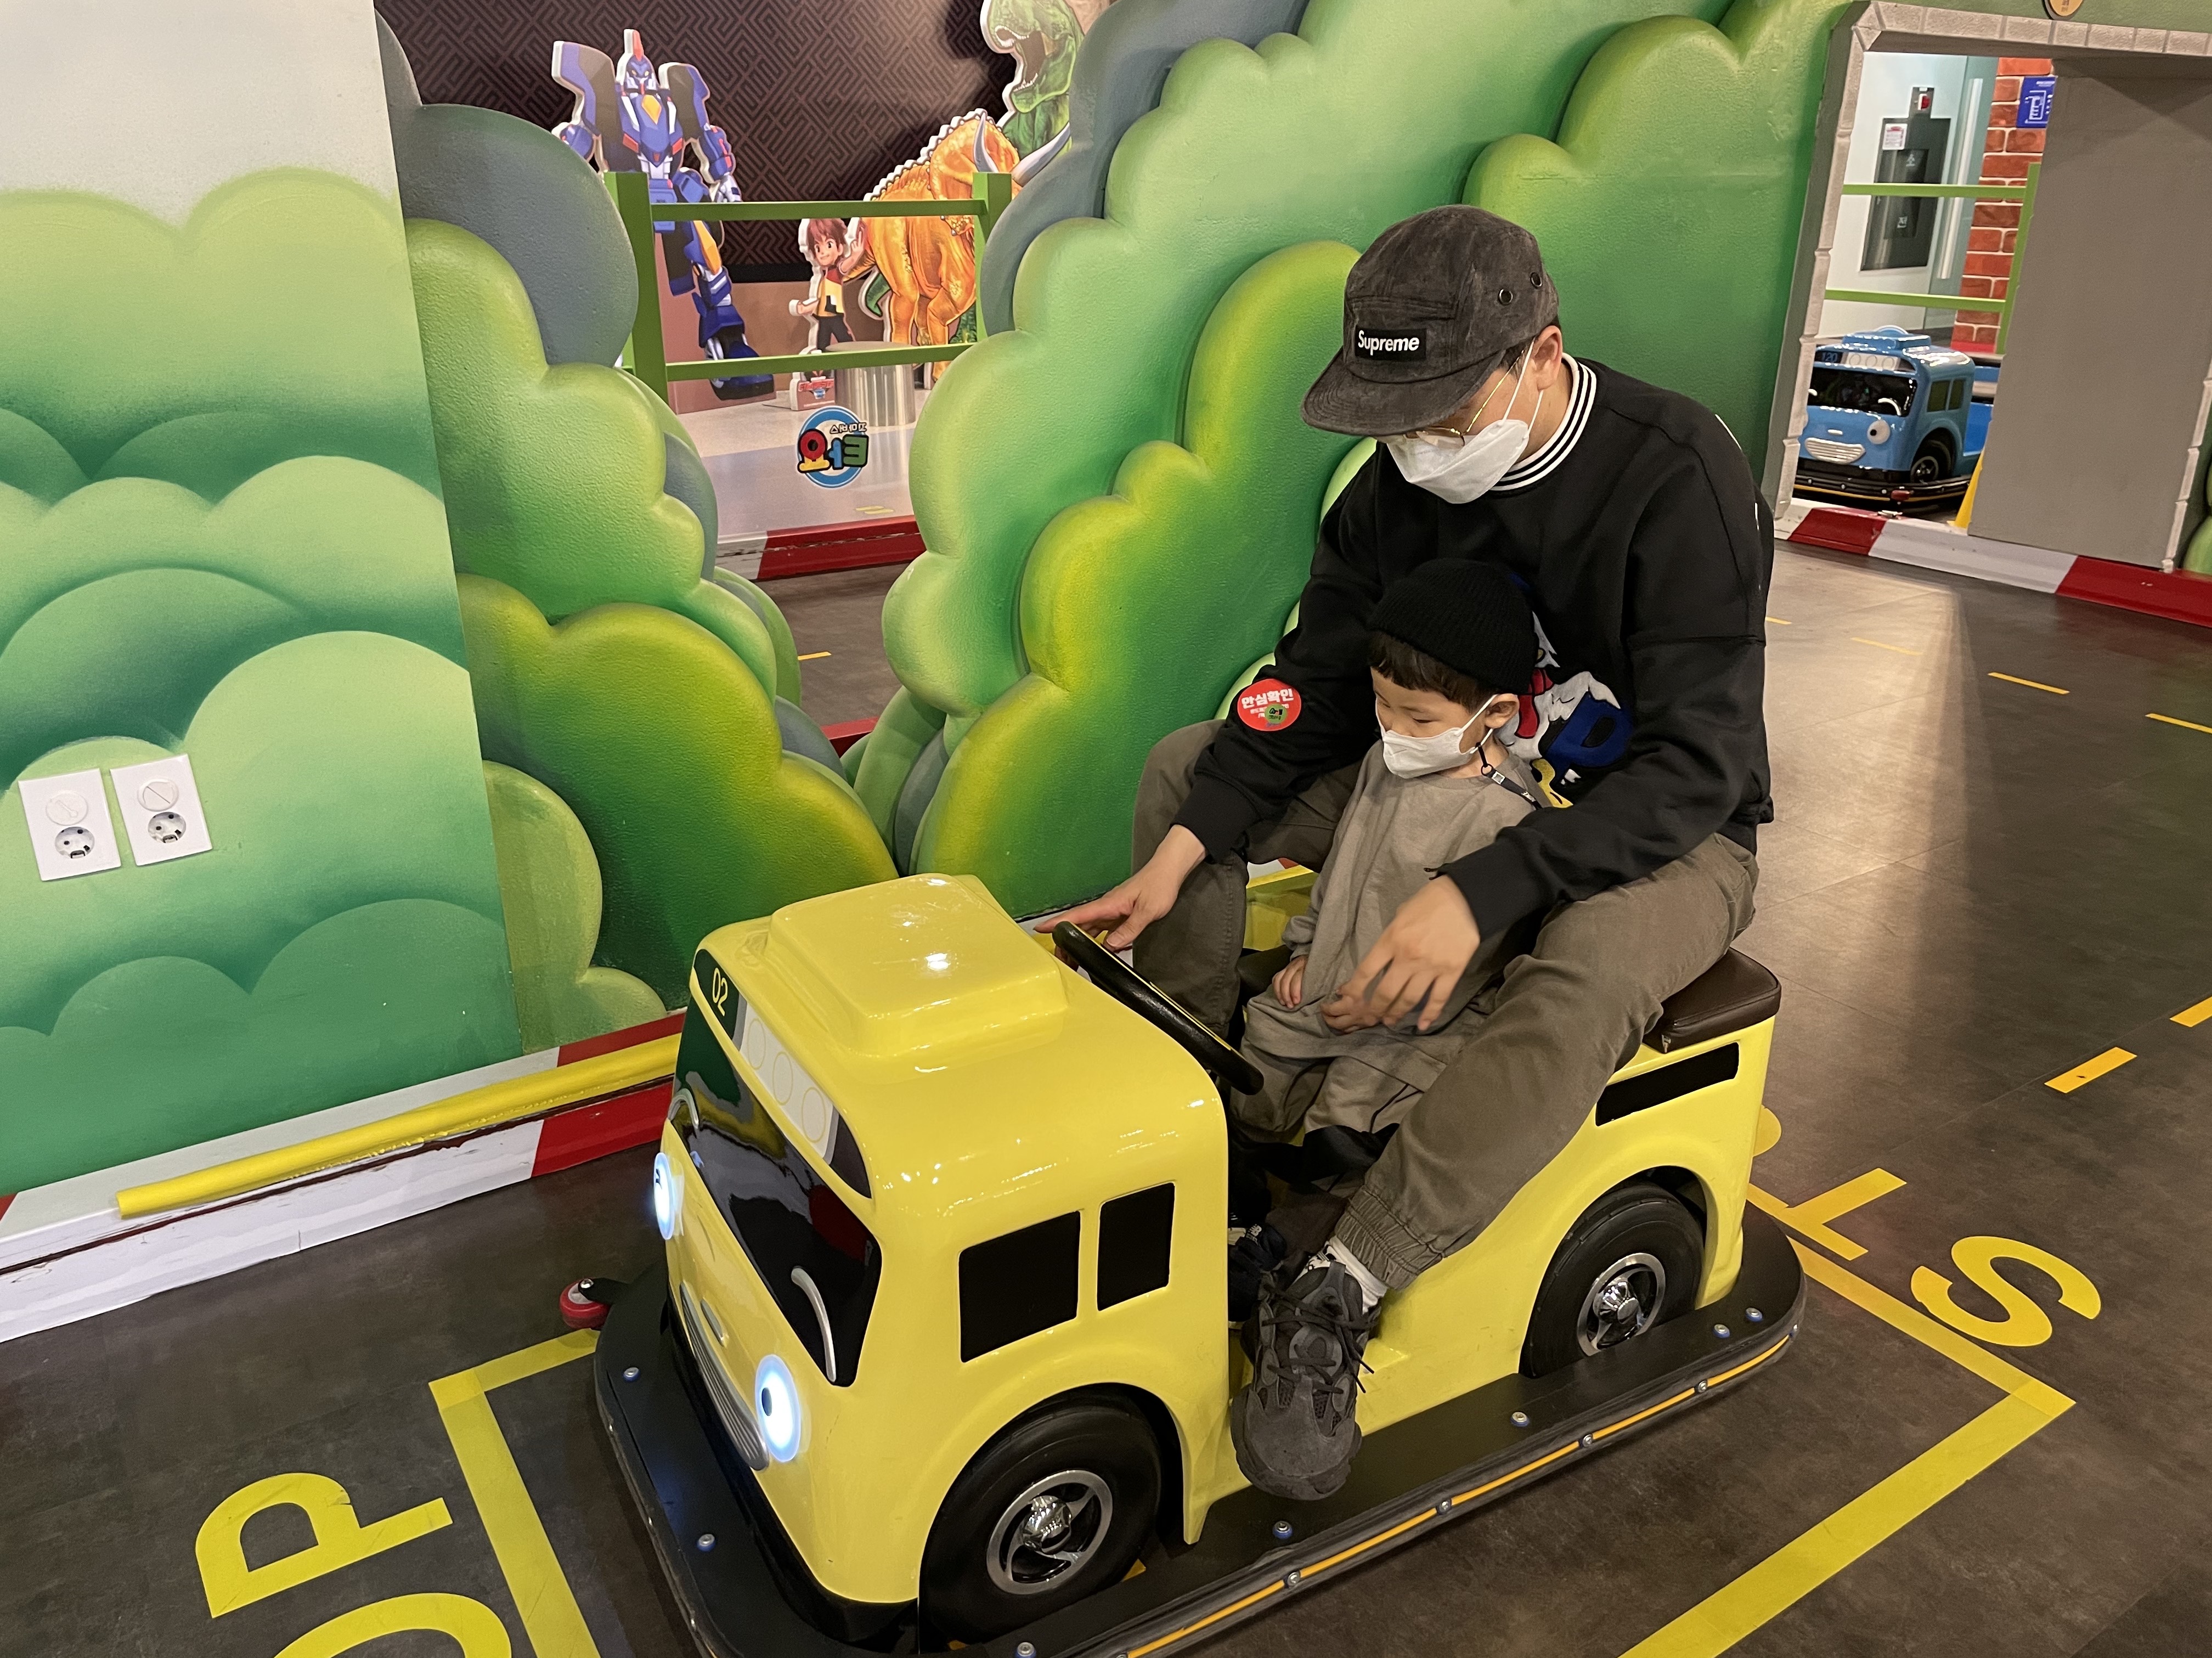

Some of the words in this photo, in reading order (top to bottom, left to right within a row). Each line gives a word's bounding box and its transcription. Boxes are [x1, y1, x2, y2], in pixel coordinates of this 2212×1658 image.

[1358, 330, 1420, 356] Supreme
[1822, 352, 1838, 363] 120
[1241, 688, 1294, 709] 안심확인
[712, 967, 729, 1017] 02
